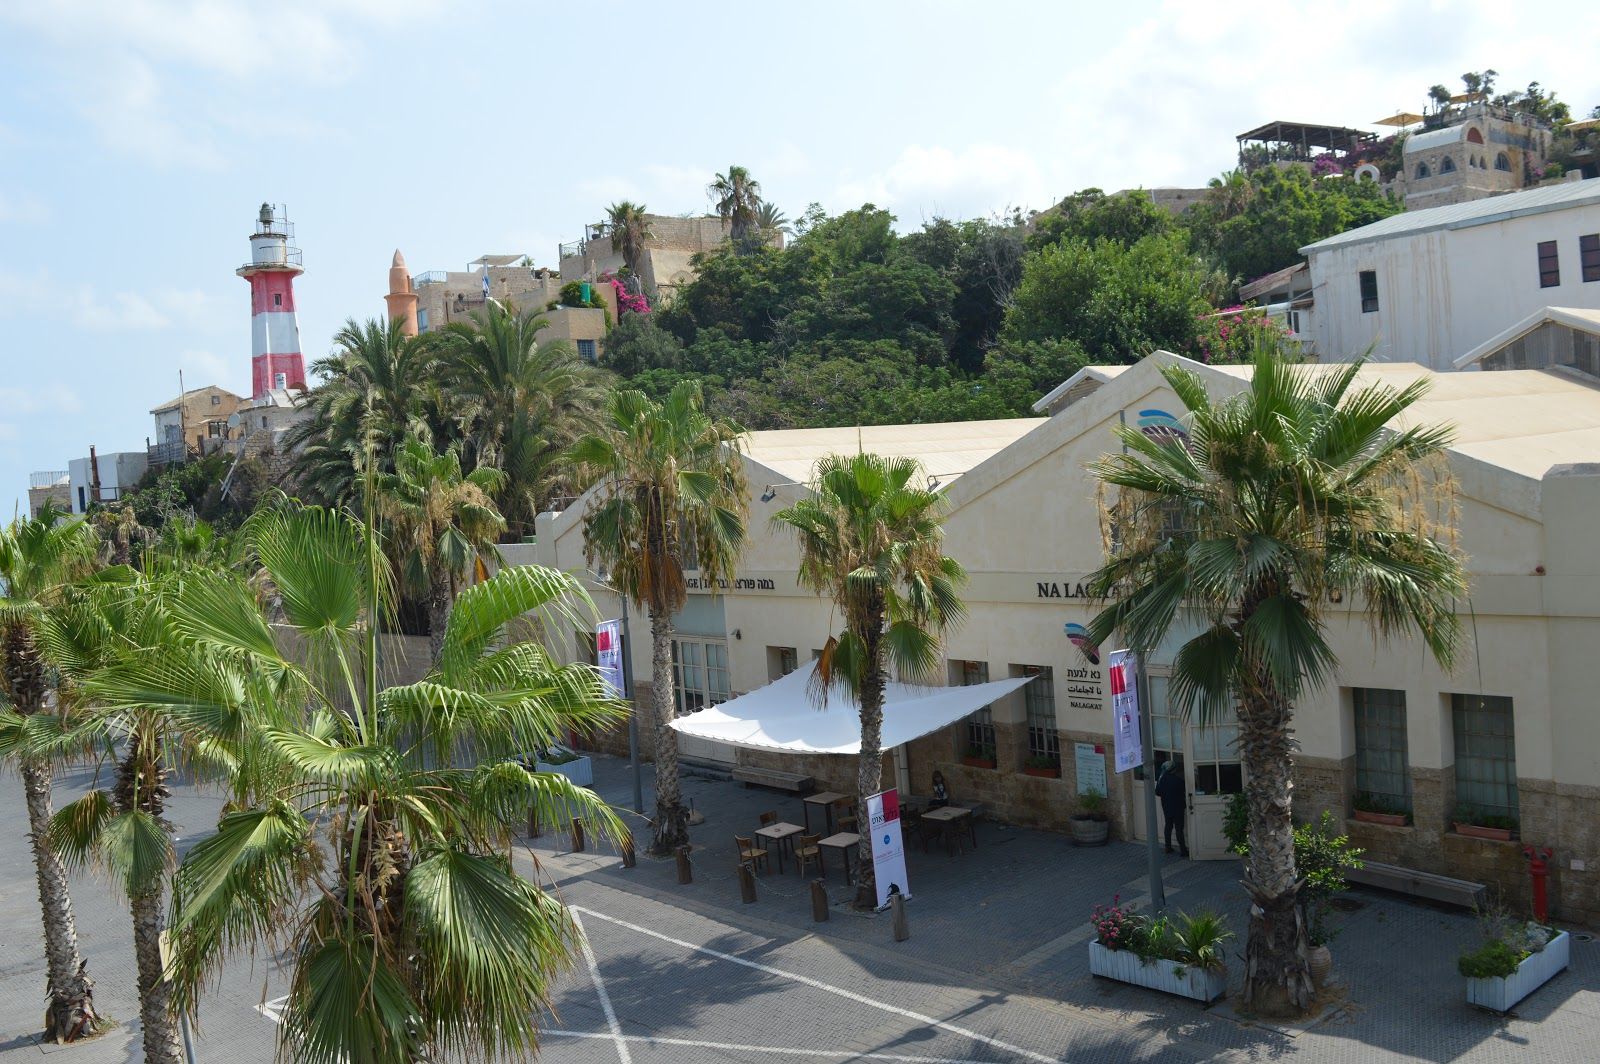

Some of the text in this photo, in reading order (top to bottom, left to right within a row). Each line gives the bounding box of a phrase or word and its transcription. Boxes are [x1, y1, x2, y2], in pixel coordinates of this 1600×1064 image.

[731, 578, 756, 590] פורצ
[757, 579, 775, 590] במה
[1037, 582, 1061, 598] NA
[1067, 667, 1101, 679] נא לגעת
